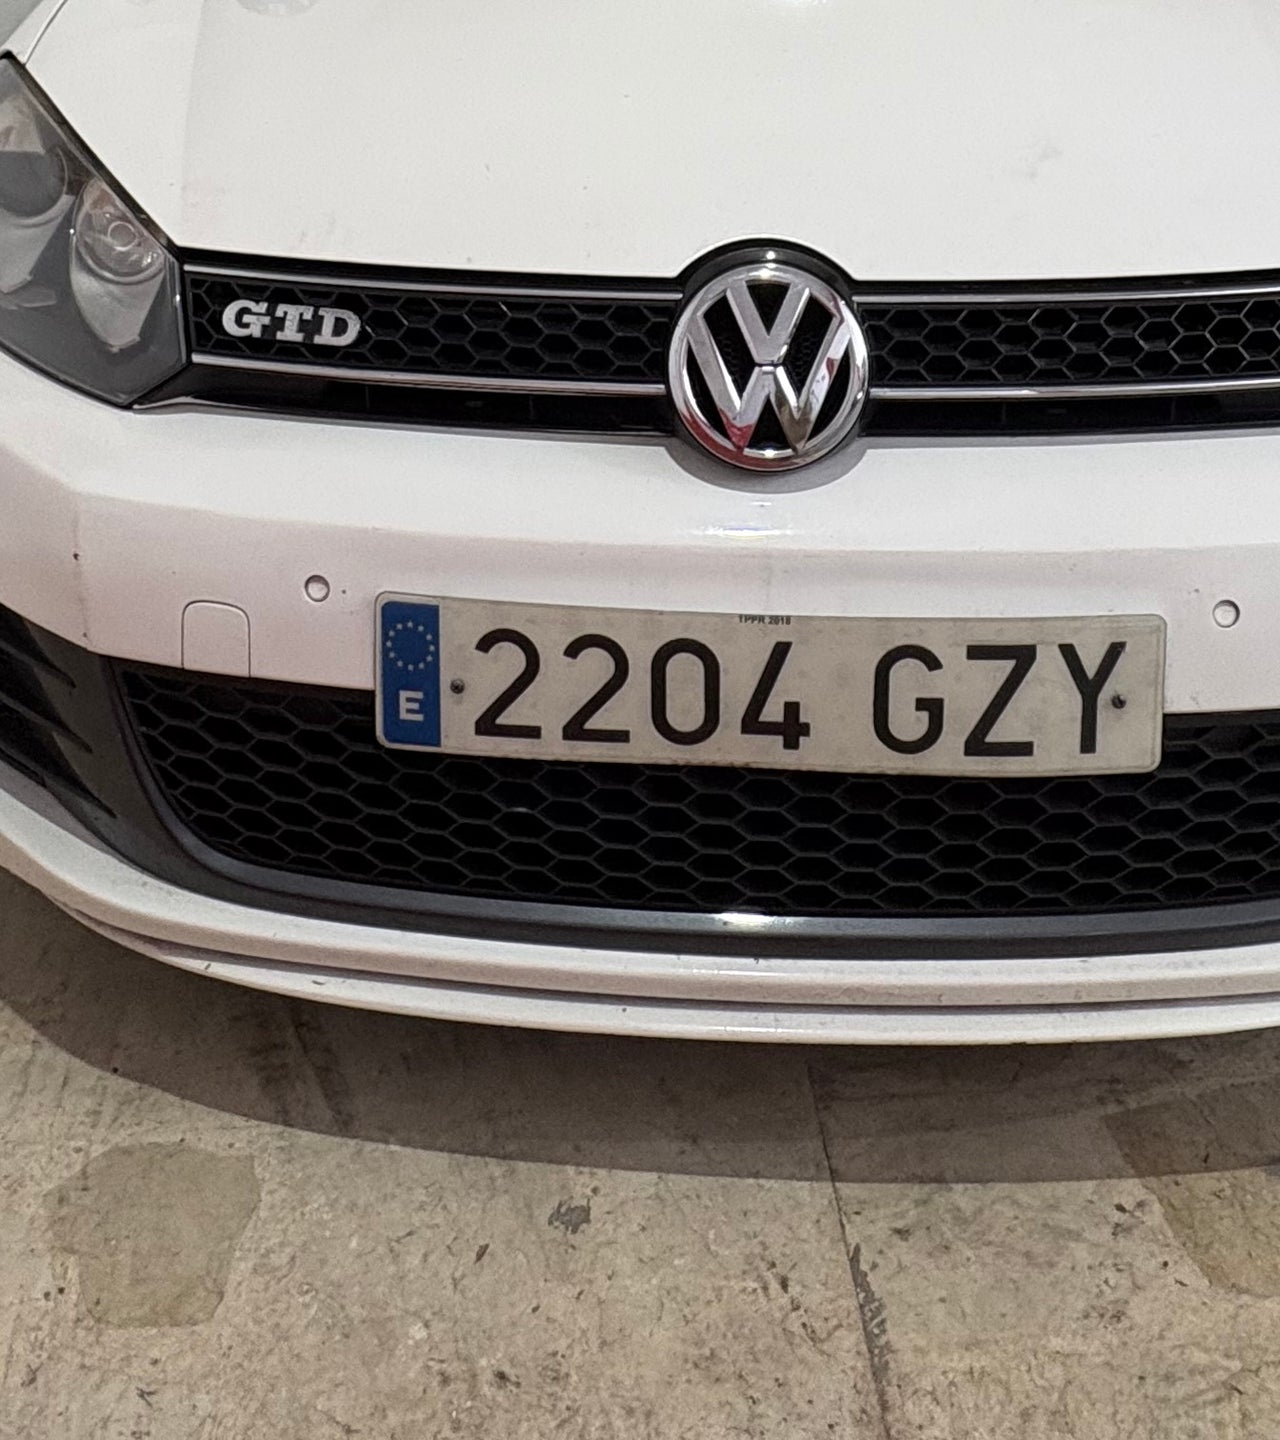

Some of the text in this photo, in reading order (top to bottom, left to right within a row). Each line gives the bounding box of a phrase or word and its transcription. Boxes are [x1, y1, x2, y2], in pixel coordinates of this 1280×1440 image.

[222, 299, 361, 346] GTD
[399, 690, 424, 721] E
[474, 628, 1127, 757] 2204 GZY
